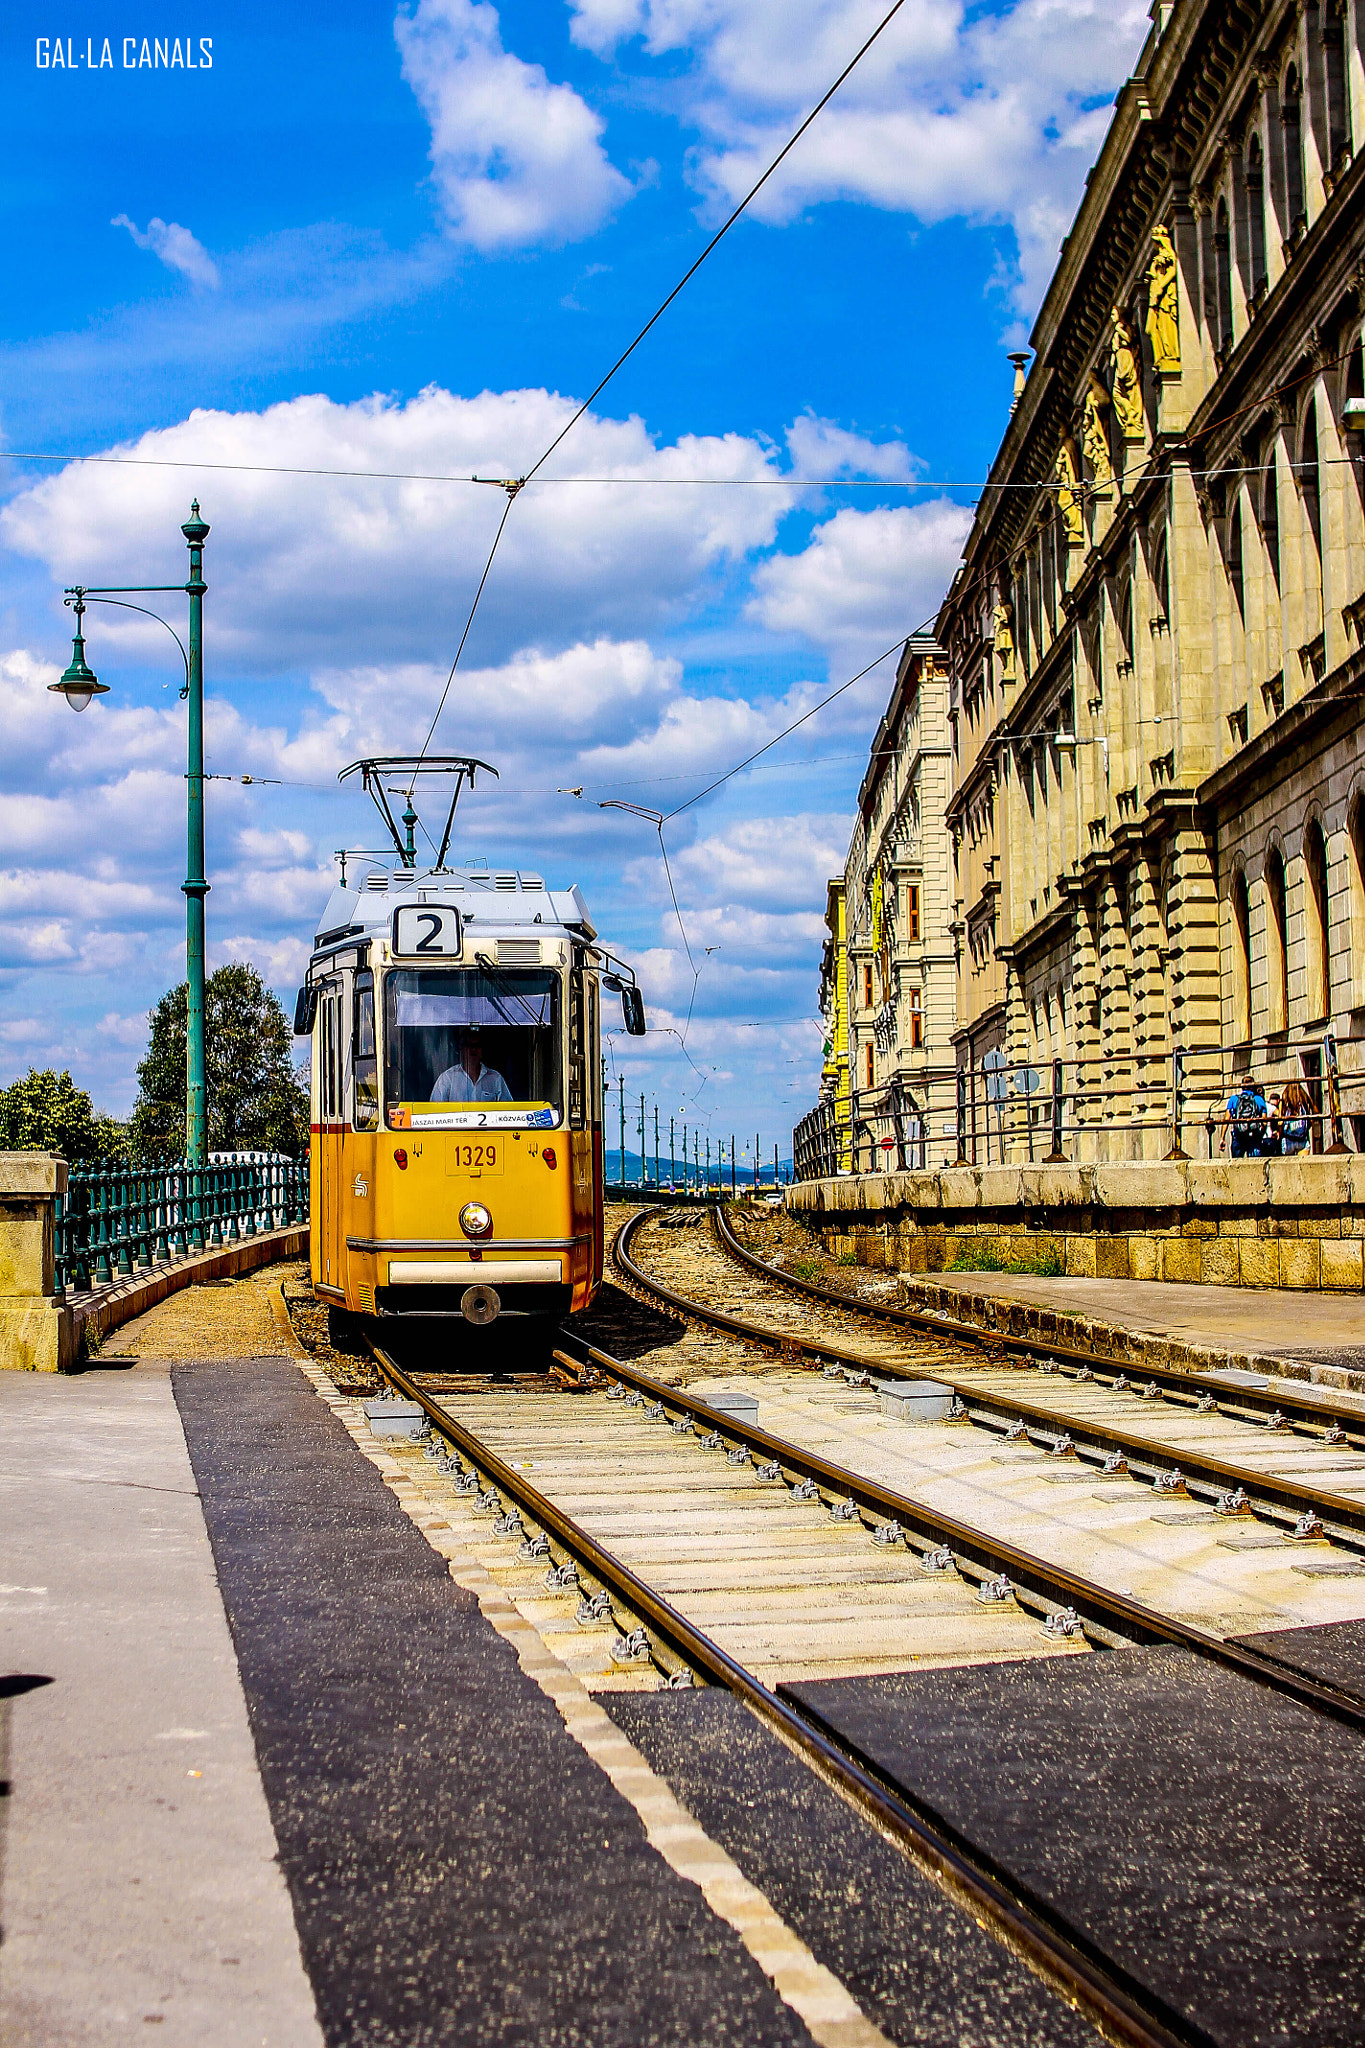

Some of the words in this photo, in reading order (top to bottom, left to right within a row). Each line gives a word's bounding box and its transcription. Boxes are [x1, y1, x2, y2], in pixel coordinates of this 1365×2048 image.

[415, 913, 444, 952] 2
[477, 1113, 488, 1127] 2
[454, 1145, 497, 1167] 1329
